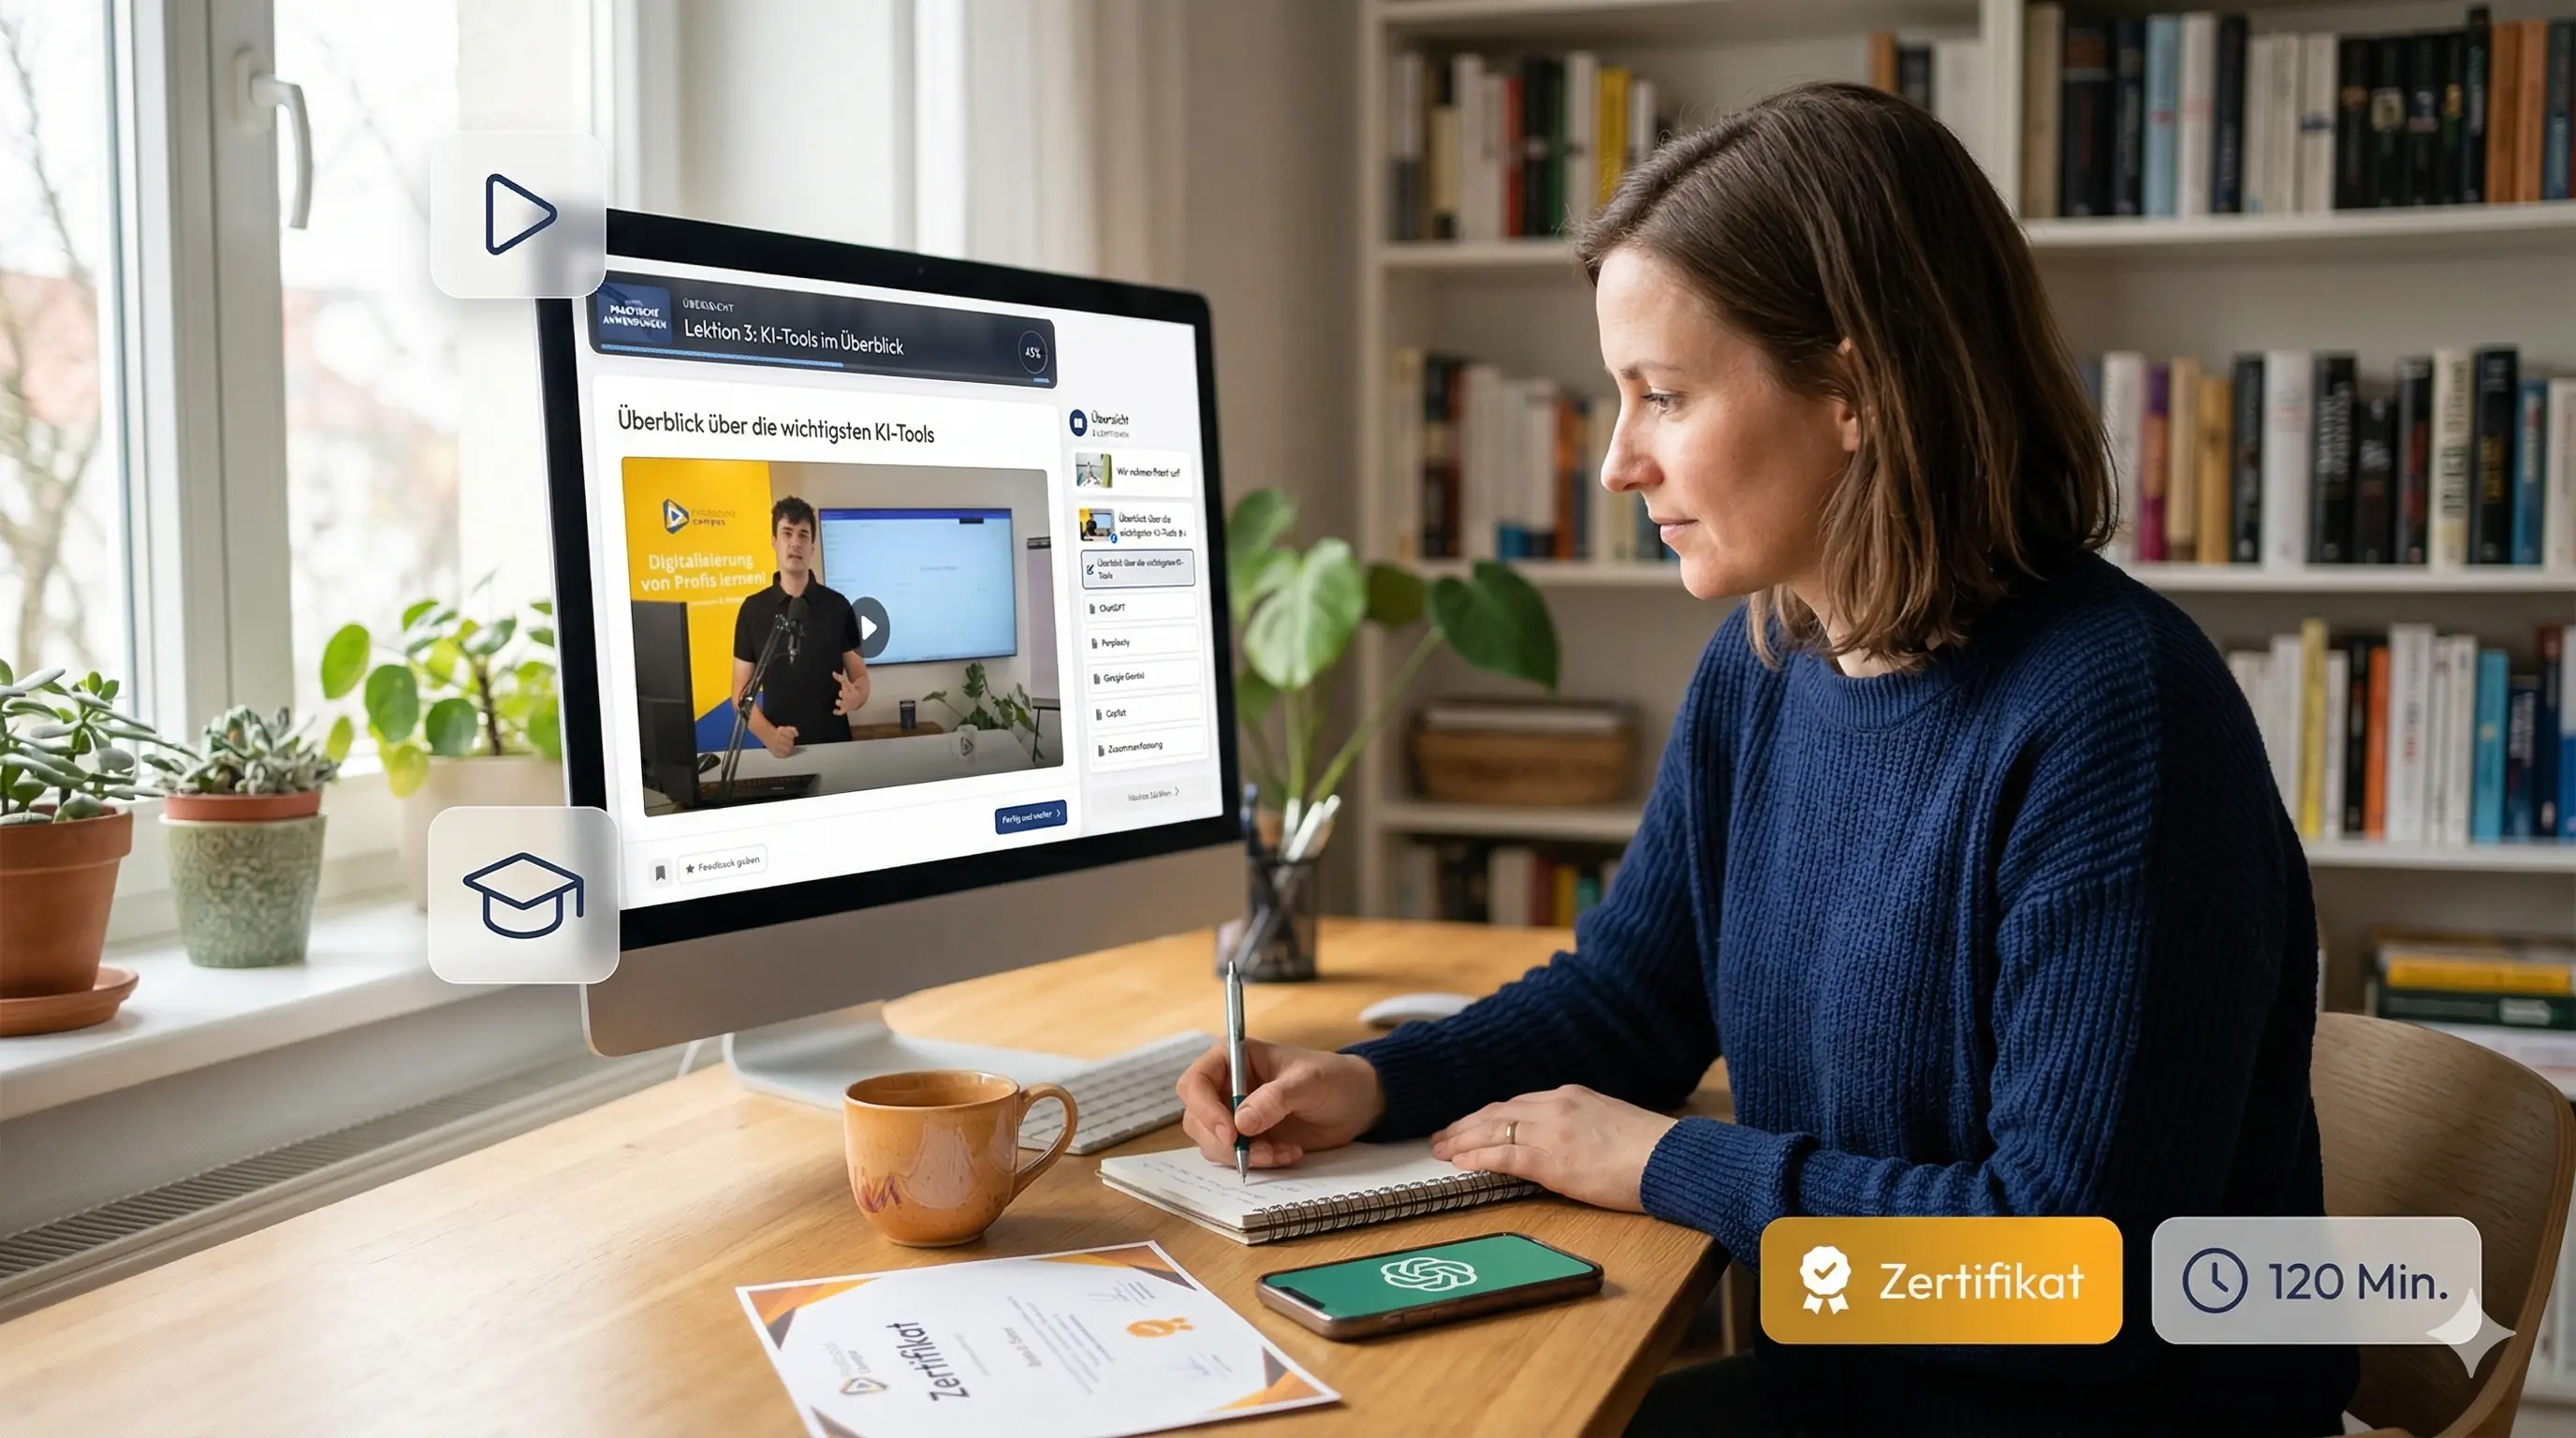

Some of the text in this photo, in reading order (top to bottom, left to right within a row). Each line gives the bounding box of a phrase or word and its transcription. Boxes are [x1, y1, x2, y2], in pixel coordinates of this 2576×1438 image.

[684, 318, 905, 356] Lektion 3: KI-Tools im Überblick
[618, 404, 935, 445] Überblick über die wichtigsten KI-Tools
[641, 578, 670, 592] von
[674, 573, 717, 591] Profis
[886, 1322, 970, 1401] Zertifikat
